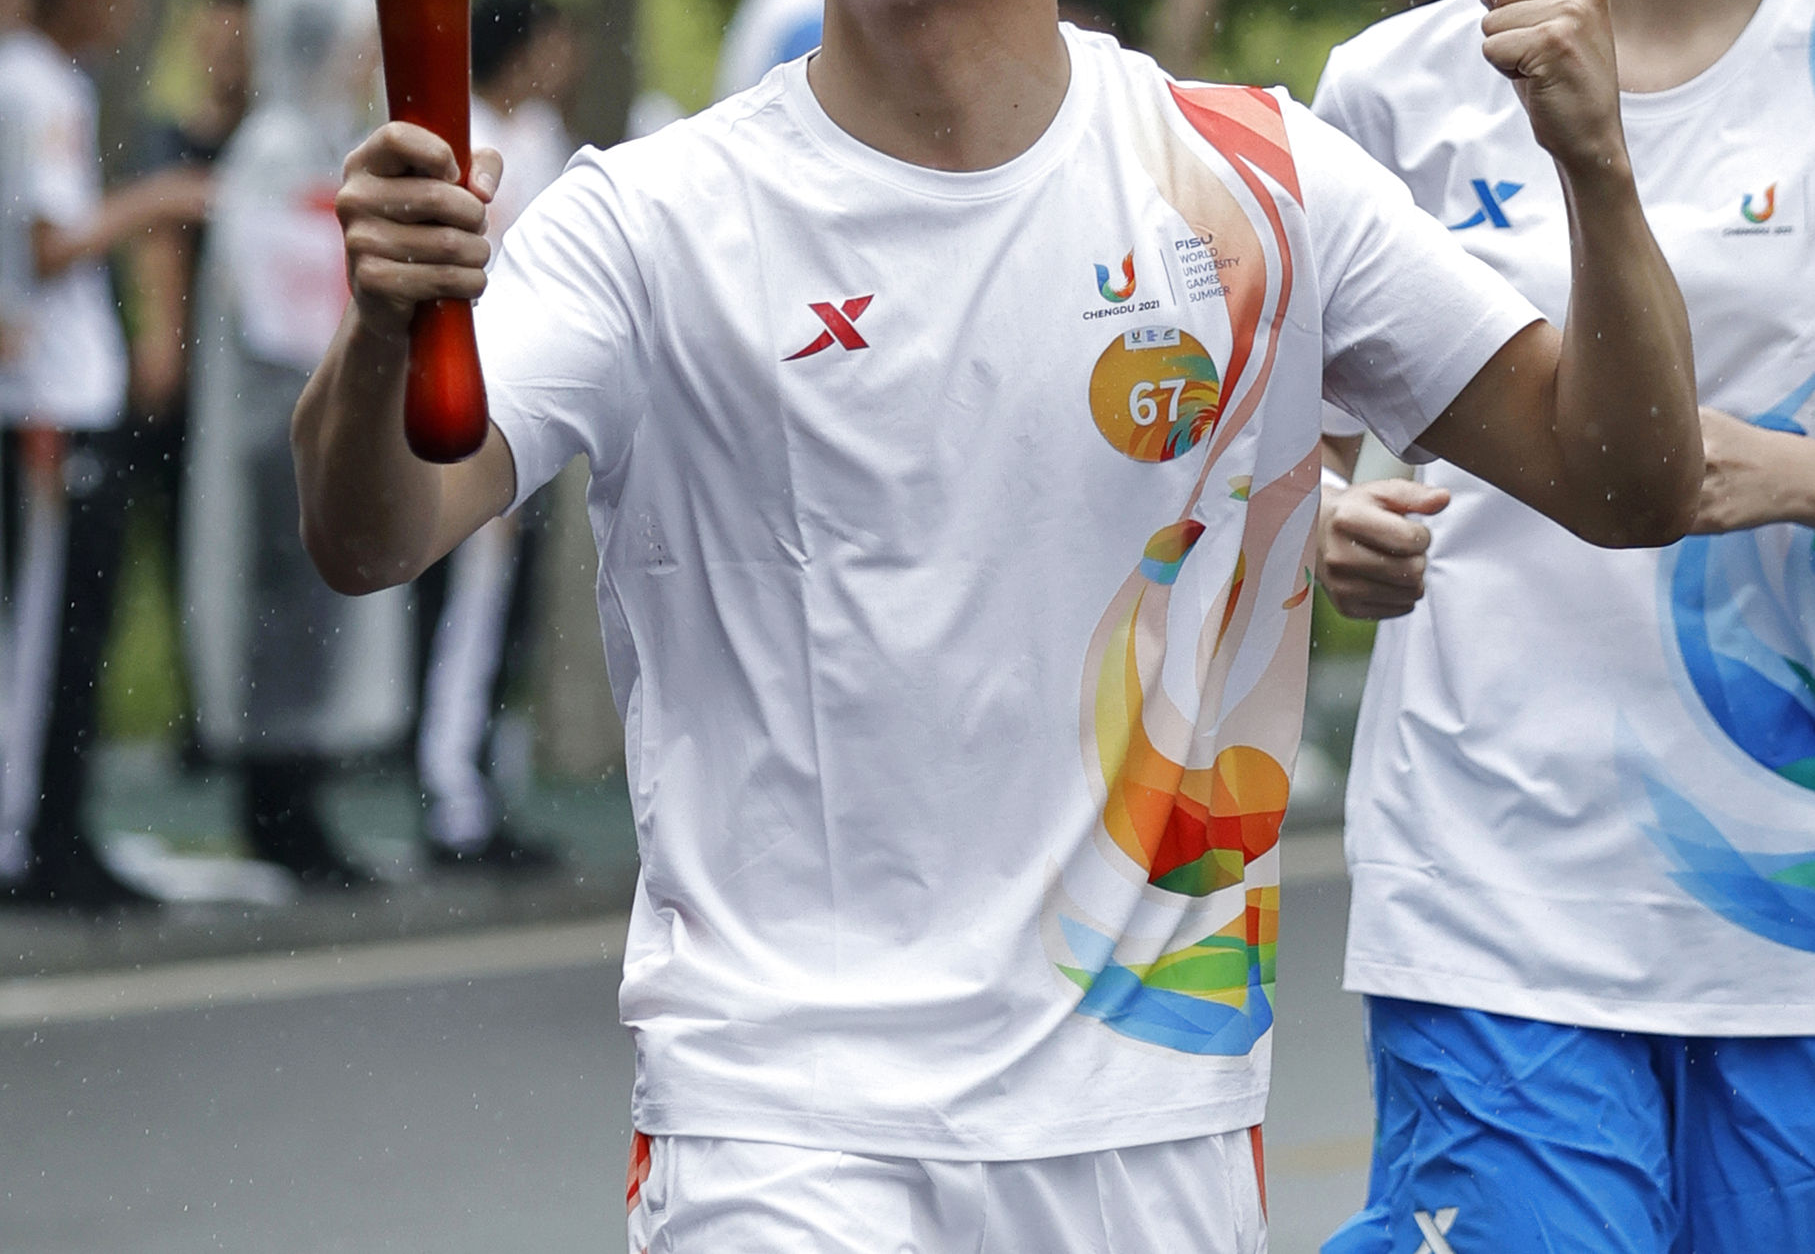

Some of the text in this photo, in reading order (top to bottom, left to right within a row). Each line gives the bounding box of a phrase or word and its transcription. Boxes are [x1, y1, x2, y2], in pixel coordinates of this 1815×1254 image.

[1175, 233, 1213, 251] FISU
[1179, 247, 1218, 264] WORLD
[1183, 257, 1241, 276] UNIVERSITY
[1186, 274, 1220, 290] GAMES
[1189, 286, 1231, 303] SUMMER
[1083, 300, 1160, 321] CHENGDU 2021
[1128, 378, 1186, 427] 67
